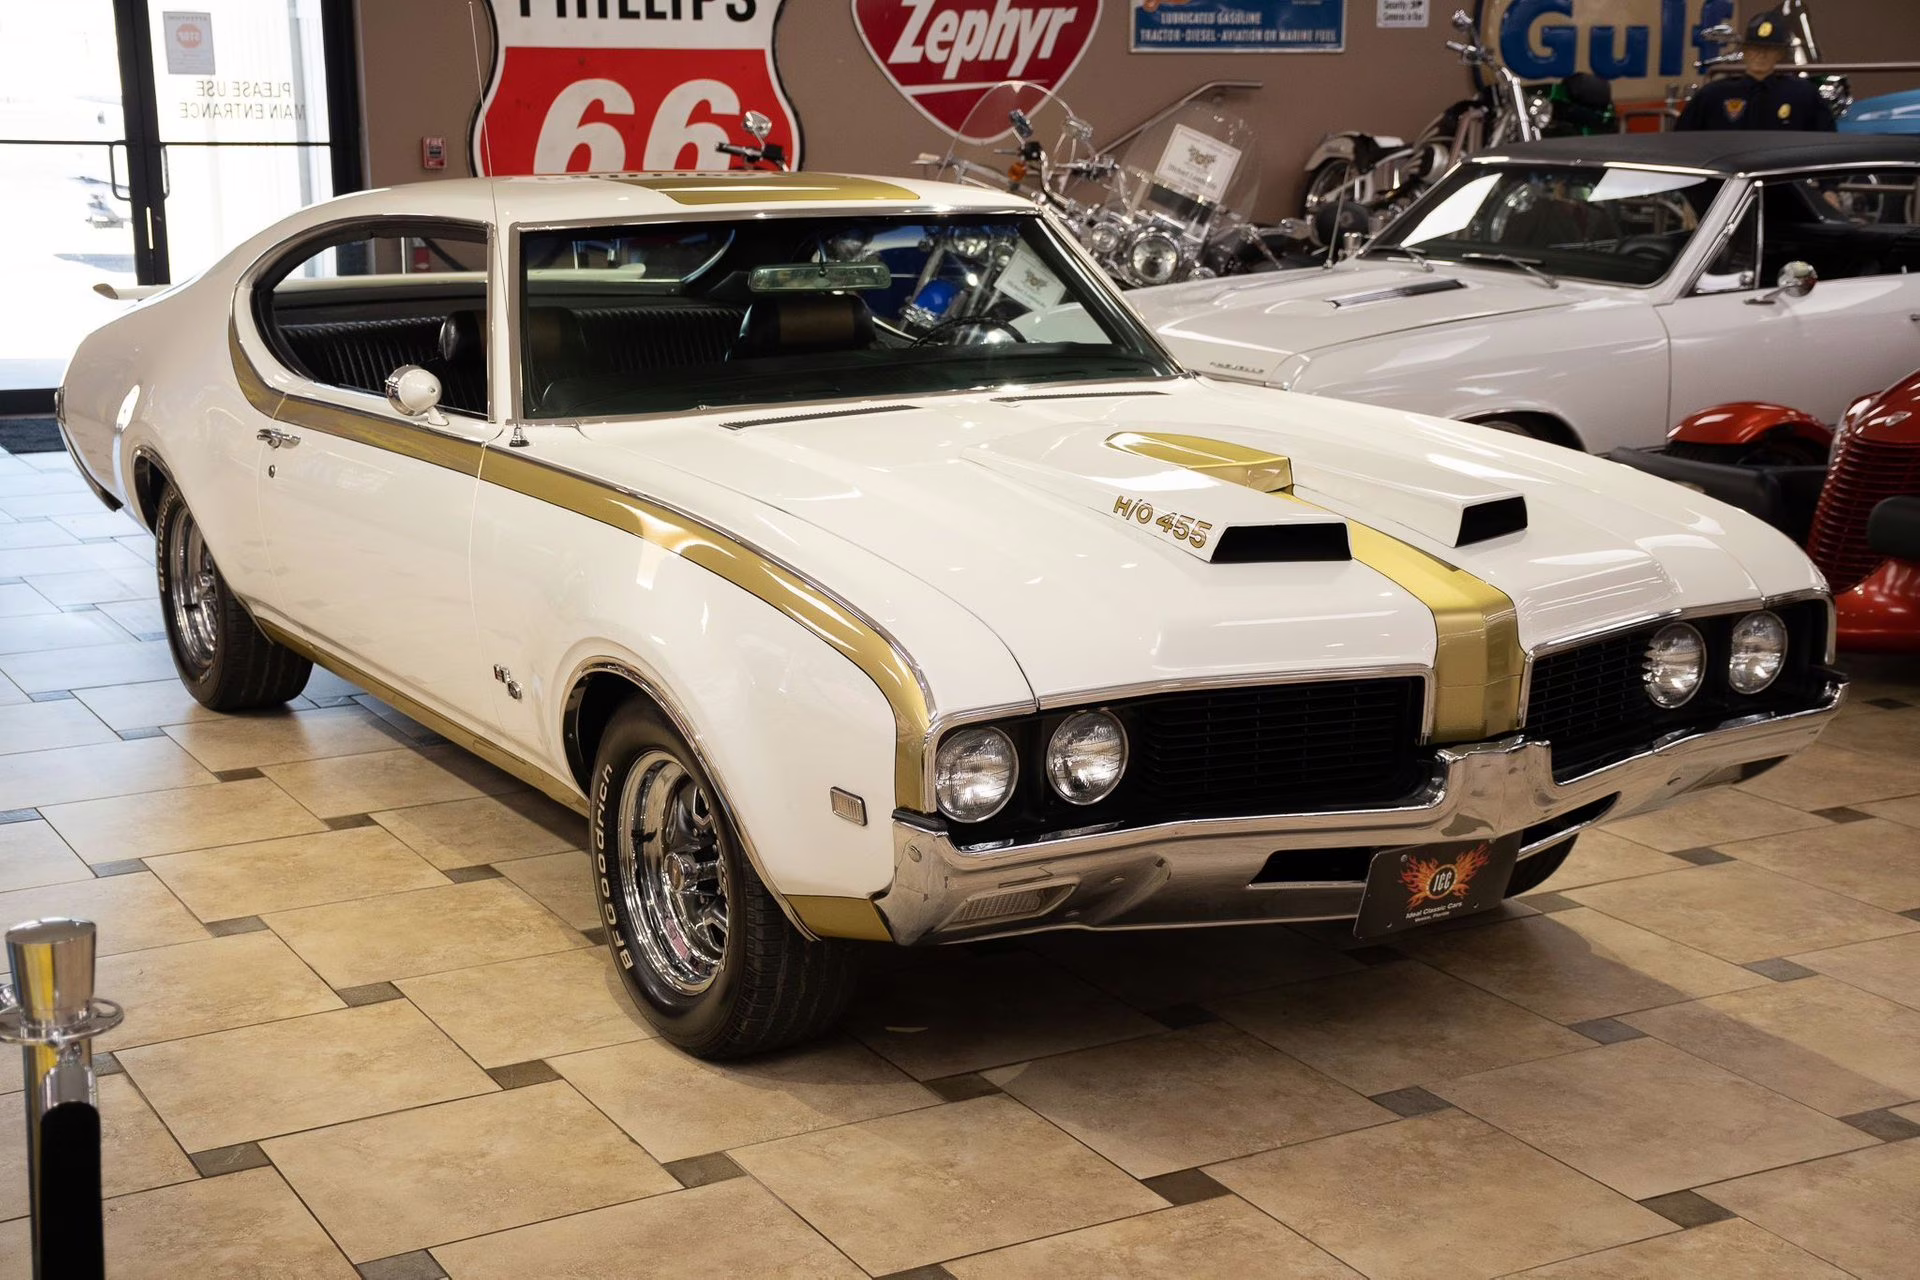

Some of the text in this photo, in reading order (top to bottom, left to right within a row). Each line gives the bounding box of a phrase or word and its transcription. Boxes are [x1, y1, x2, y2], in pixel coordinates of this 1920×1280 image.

[887, 0, 1078, 80] Zephyr
[1140, 29, 1336, 41] TRACTOR DIESEL AVIATION OR MARINE FUEL
[1161, 11, 1262, 24] LUBRICATED GASOLINE
[1500, 0, 1733, 80] Gulf
[533, 78, 741, 173] 66
[1113, 496, 1212, 548] H/O 455
[595, 763, 634, 970] BFGoodrich
[1423, 905, 1447, 915] Classic
